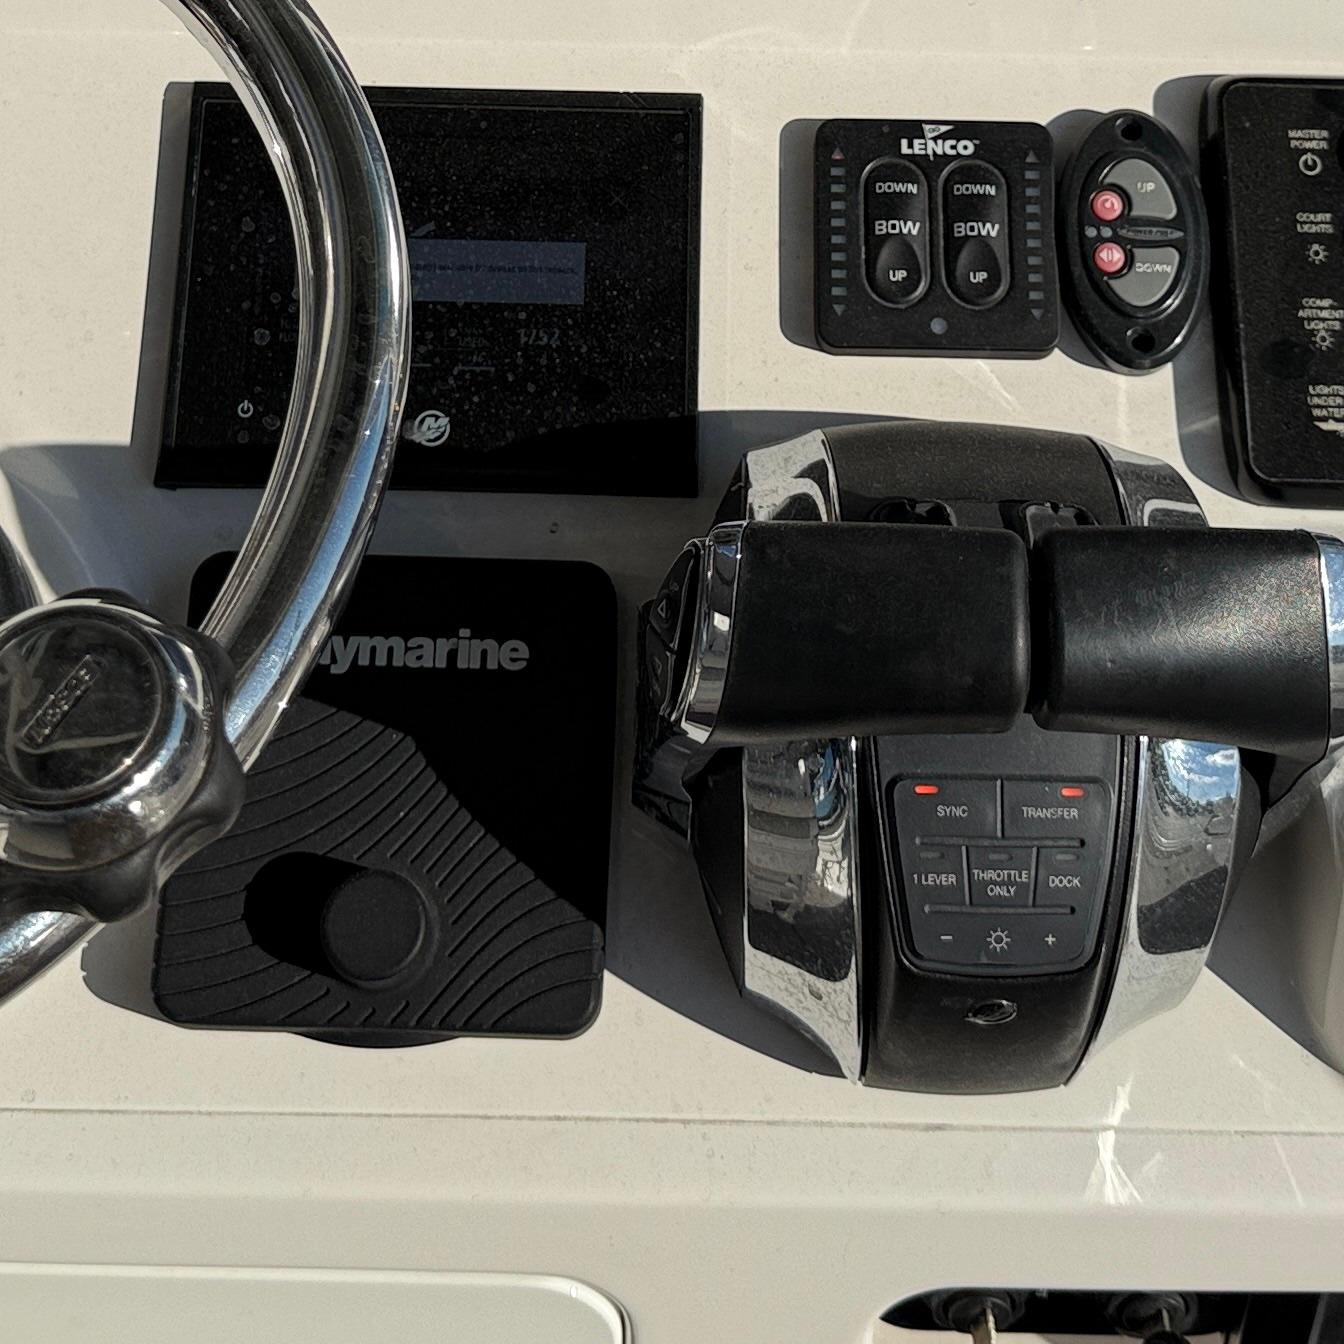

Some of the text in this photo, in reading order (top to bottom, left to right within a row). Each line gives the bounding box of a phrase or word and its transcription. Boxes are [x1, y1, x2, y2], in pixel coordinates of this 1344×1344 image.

[1287, 129, 1329, 139] MASTER
[900, 137, 977, 160] LENCO
[1289, 139, 1329, 150] POWER
[875, 181, 918, 195] DOWN
[953, 183, 996, 197] DOWN
[1136, 182, 1156, 193] UP
[1296, 212, 1333, 222] COURT
[874, 219, 920, 236] BOW
[953, 222, 1000, 238] BOW
[1296, 222, 1334, 234] LIGHTS
[1135, 262, 1172, 273] DOWN
[888, 269, 908, 283] UP
[968, 271, 988, 284] UP
[318, 628, 530, 674] ymarine
[936, 805, 1079, 820] SYNC TRANSFER
[921, 873, 957, 886] LEVER
[972, 869, 1029, 883] THROTTLE
[1048, 875, 1081, 888] DOCK
[986, 884, 1017, 897] ONLY
